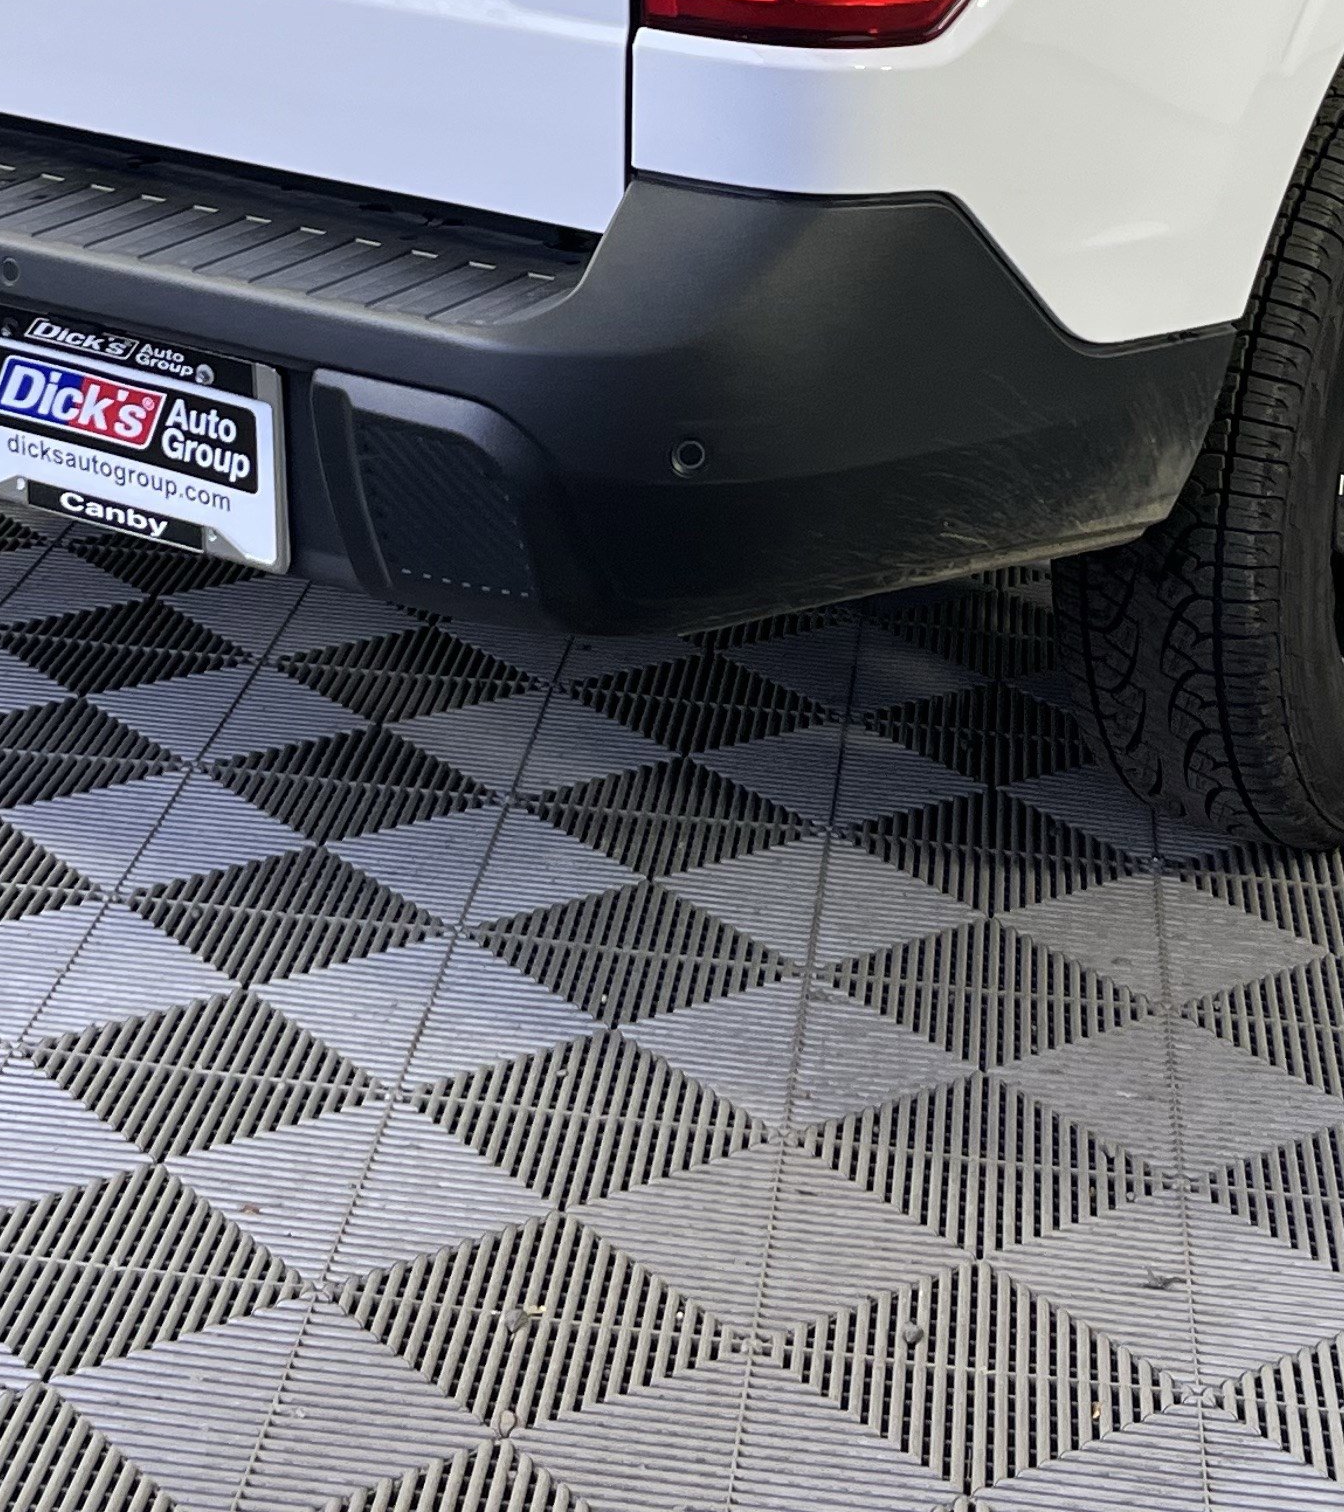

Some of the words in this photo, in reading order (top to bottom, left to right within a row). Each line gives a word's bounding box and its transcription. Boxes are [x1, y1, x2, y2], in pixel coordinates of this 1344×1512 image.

[32, 321, 130, 356] Dick's
[138, 342, 186, 364] Auto
[134, 352, 194, 378] Group
[165, 398, 237, 444] Auto
[6, 433, 232, 512] dicksautogroup.com
[161, 429, 251, 482] Group
[58, 490, 169, 538] Canby
